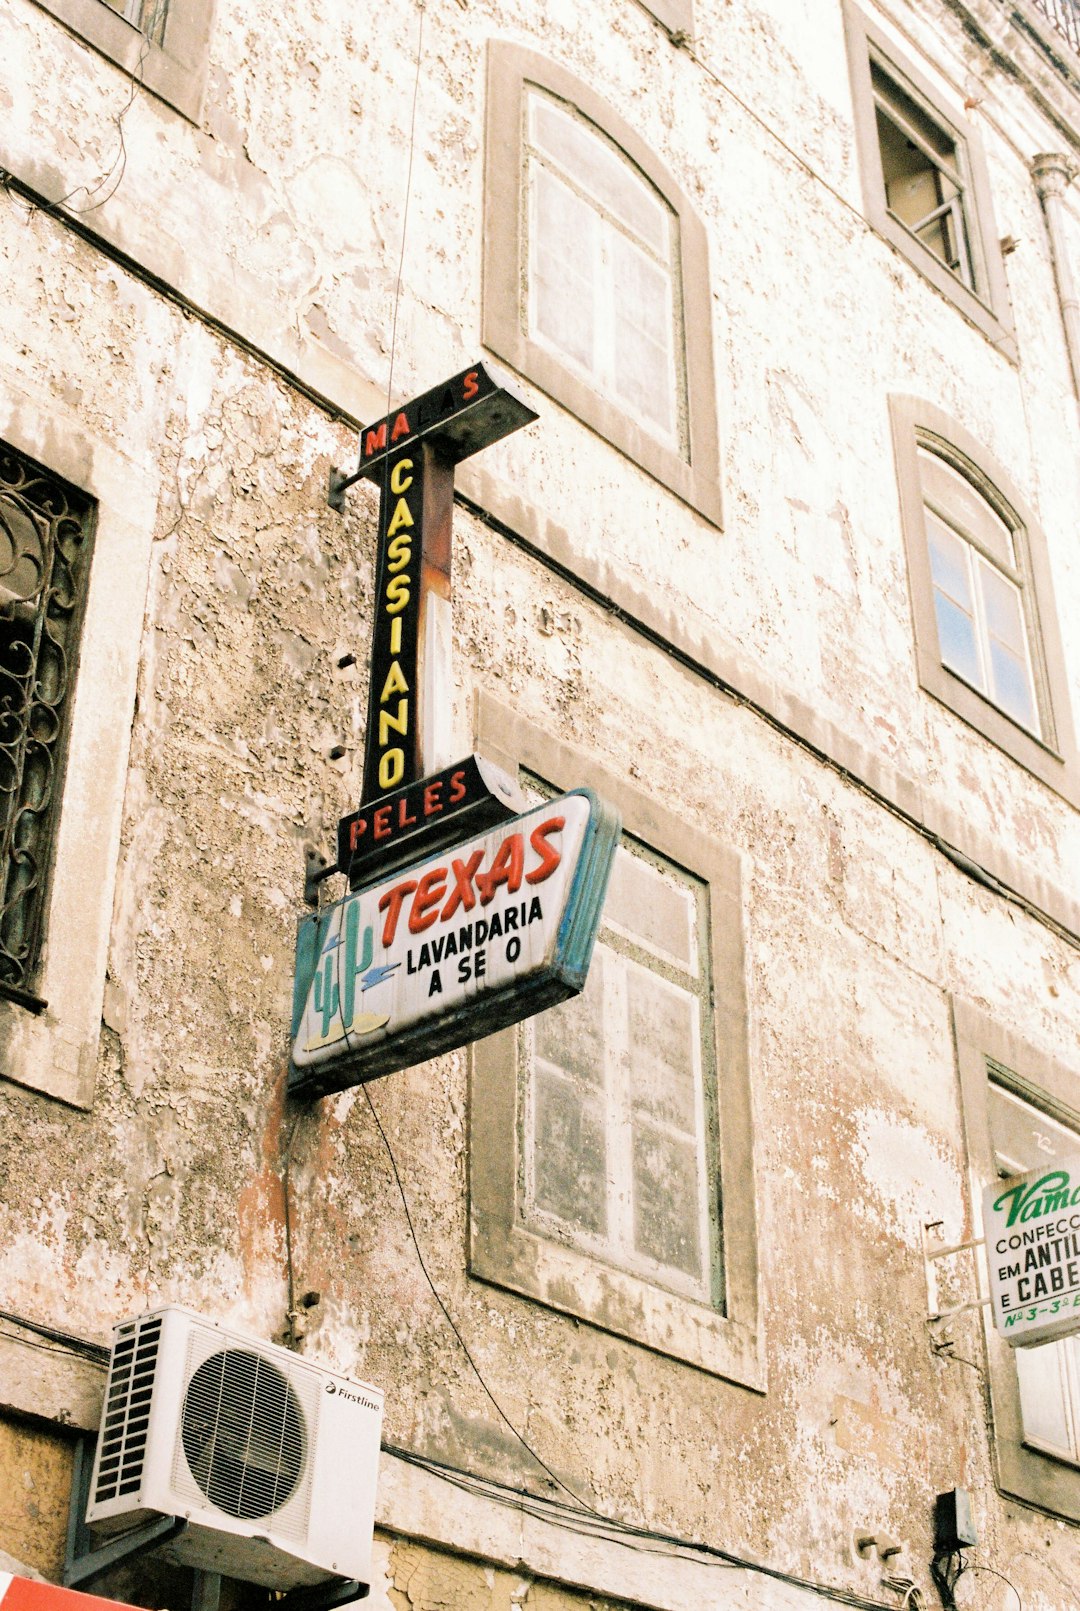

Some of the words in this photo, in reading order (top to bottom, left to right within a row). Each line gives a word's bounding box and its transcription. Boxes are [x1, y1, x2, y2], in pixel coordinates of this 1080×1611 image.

[378, 458, 415, 790] CASSIANO
[350, 771, 466, 850] PELES
[378, 816, 566, 948] TEXAS
[407, 897, 543, 975] LAVANDARIA
[998, 1262, 1021, 1281] EM
[1001, 1293, 1010, 1308] E
[338, 1388, 380, 1411] Firstline
